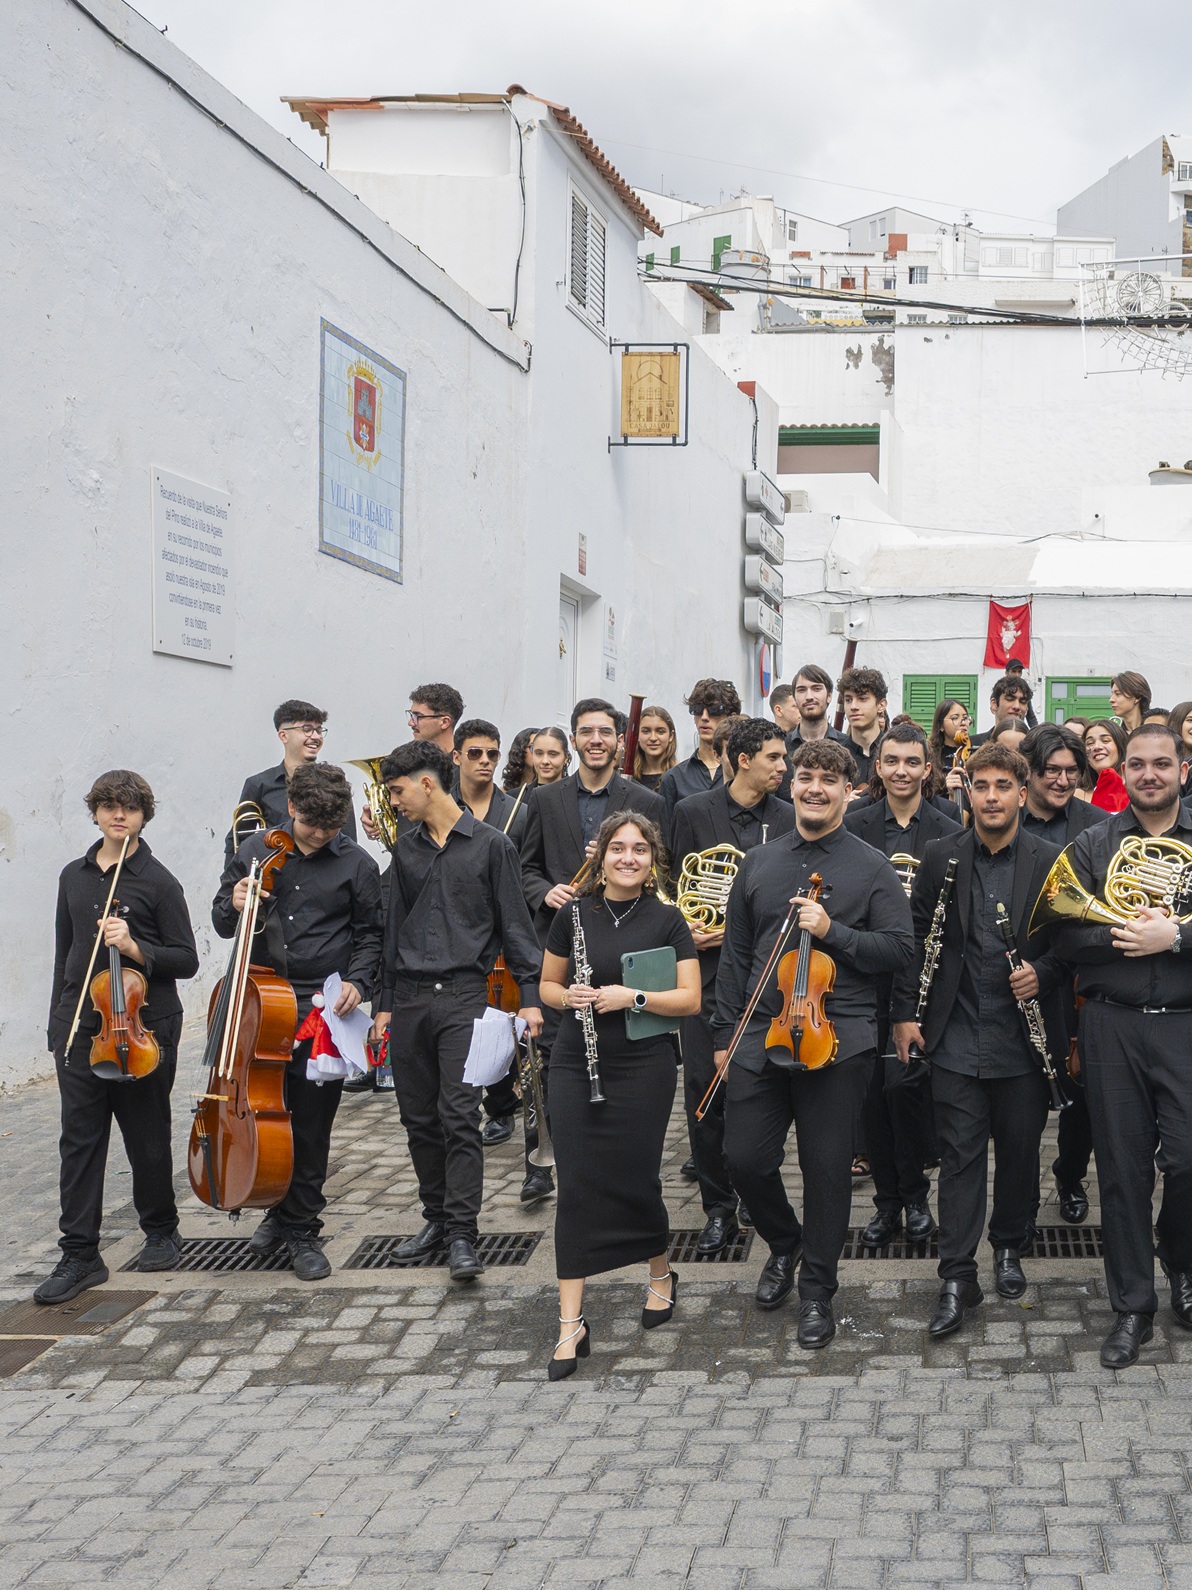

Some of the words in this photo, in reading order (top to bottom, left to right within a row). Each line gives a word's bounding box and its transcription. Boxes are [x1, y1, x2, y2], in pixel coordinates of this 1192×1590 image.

[202, 500, 215, 516] Nuestra
[331, 479, 355, 515] VILLA
[365, 498, 394, 531] AGAETE
[198, 518, 206, 532] Villa
[176, 572, 188, 586] nuestra
[217, 583, 226, 596] 2019
